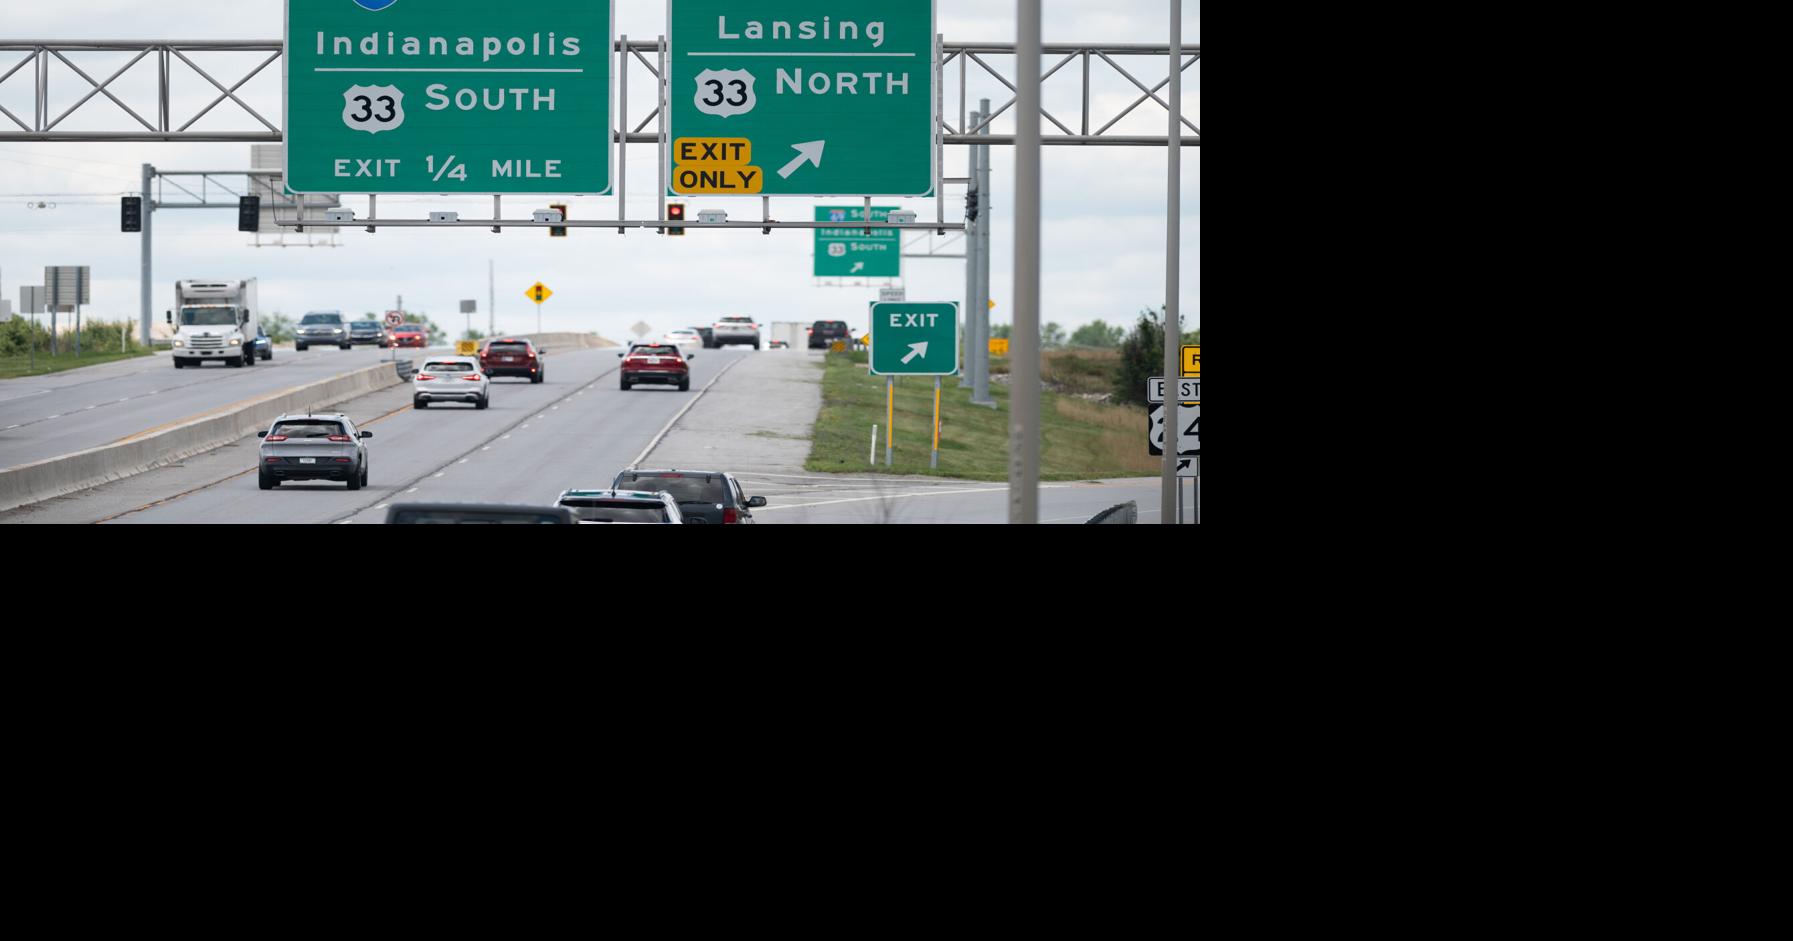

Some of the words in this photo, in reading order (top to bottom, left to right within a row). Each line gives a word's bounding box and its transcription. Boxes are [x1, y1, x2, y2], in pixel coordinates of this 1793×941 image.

[718, 15, 885, 48] Lansing
[316, 31, 581, 62] Indianapolis
[702, 79, 748, 107] 33
[775, 68, 909, 95] NORTH
[350, 95, 396, 123] 33
[425, 83, 556, 111] SOUTH
[680, 142, 746, 161] EXIT
[334, 158, 401, 177] EXIT
[491, 159, 562, 177] MILE
[679, 170, 757, 189] ONLY
[889, 313, 939, 328] EXIT
[1157, 382, 1200, 397] EST
